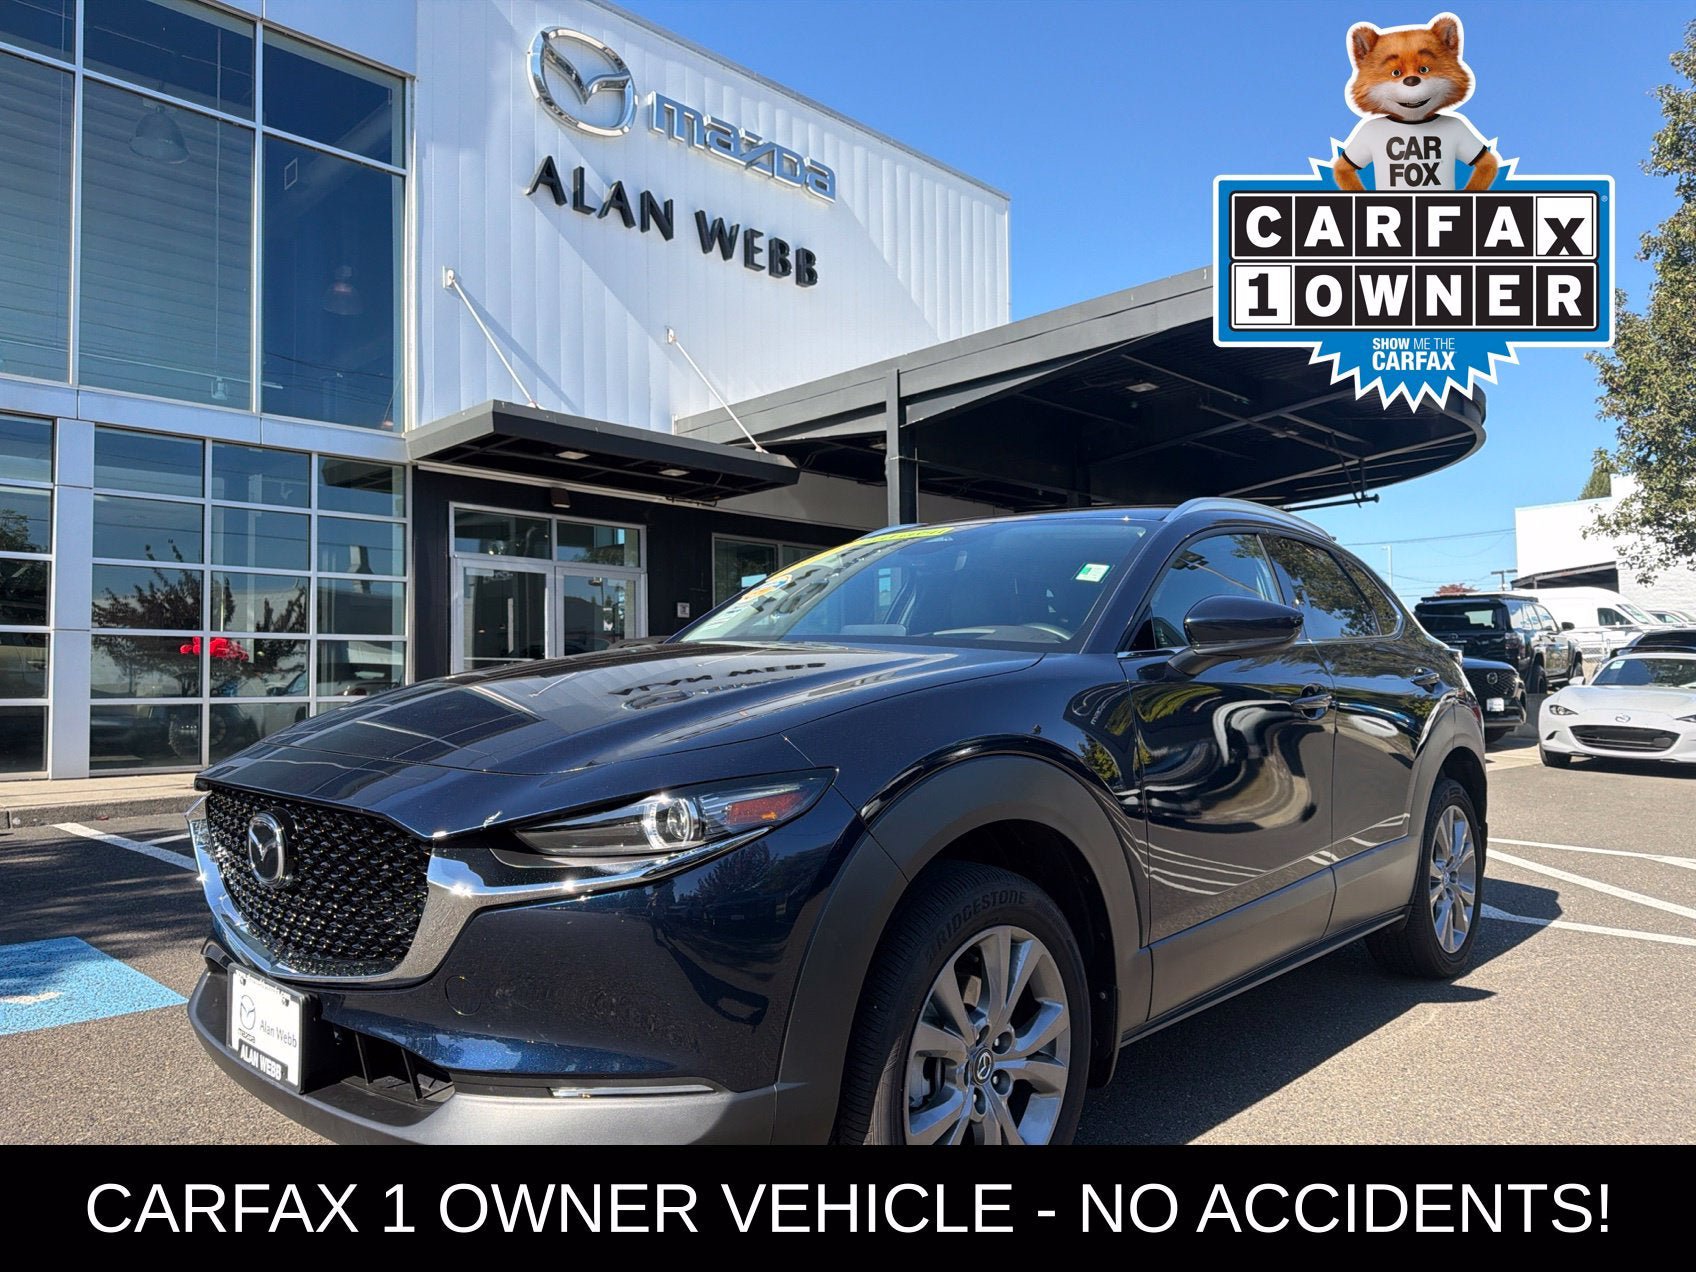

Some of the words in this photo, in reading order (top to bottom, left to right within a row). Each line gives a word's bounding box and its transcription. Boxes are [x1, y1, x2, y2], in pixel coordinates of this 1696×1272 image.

[648, 90, 836, 204] mazda
[526, 155, 674, 242] ALAN
[694, 210, 818, 288] WEBB
[240, 1044, 260, 1069] ALAN
[259, 1054, 282, 1081] WEBB
[260, 1019, 275, 1038] Alan
[275, 1026, 297, 1048] Webb
